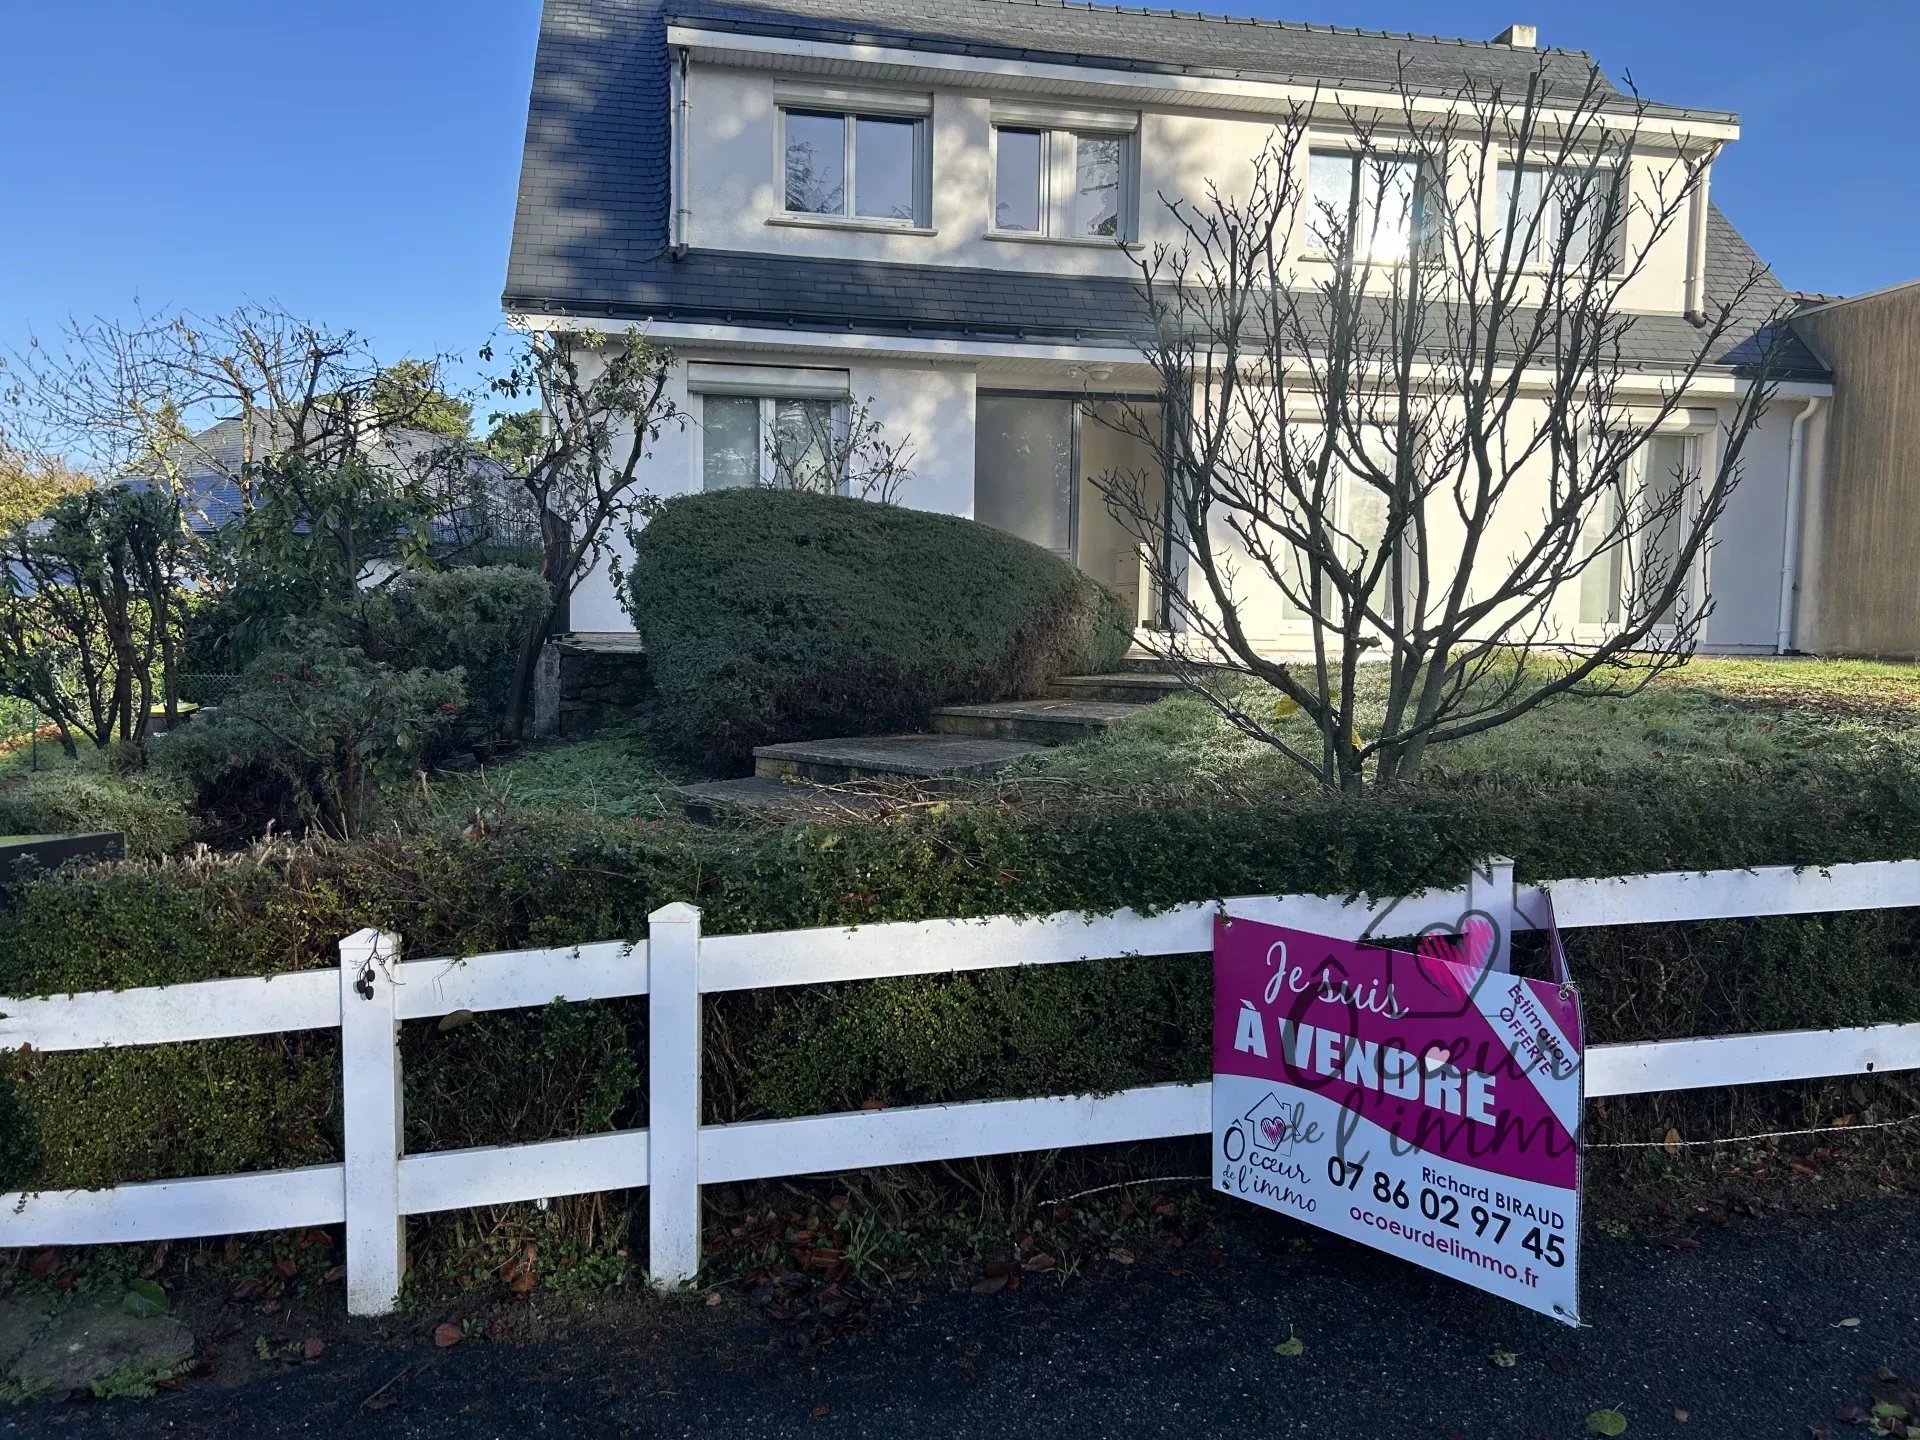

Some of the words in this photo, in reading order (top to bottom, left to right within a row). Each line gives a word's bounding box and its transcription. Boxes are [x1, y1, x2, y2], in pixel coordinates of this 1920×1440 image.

[1264, 940, 1310, 1004] Je
[1316, 968, 1410, 1020] suis
[1233, 998, 1268, 1059] À
[1277, 1016, 1497, 1127] VENDRE
[1499, 1006, 1553, 1076] OFFERTE
[1507, 983, 1573, 1072] Estimation
[1222, 1164, 1236, 1180] de
[1238, 1164, 1317, 1213] l'immo
[1223, 1118, 1246, 1163] Ô
[1249, 1151, 1312, 1184] cœur
[1327, 1155, 1364, 1192] 07
[1372, 1171, 1410, 1210] 86
[1419, 1187, 1460, 1230] 02
[1471, 1205, 1512, 1245] 97
[1521, 1226, 1566, 1269] 45
[1421, 1166, 1490, 1204] Richard
[1495, 1191, 1565, 1230] BIRAUD
[1349, 1206, 1540, 1289] ocoeurdelimmo.fr
